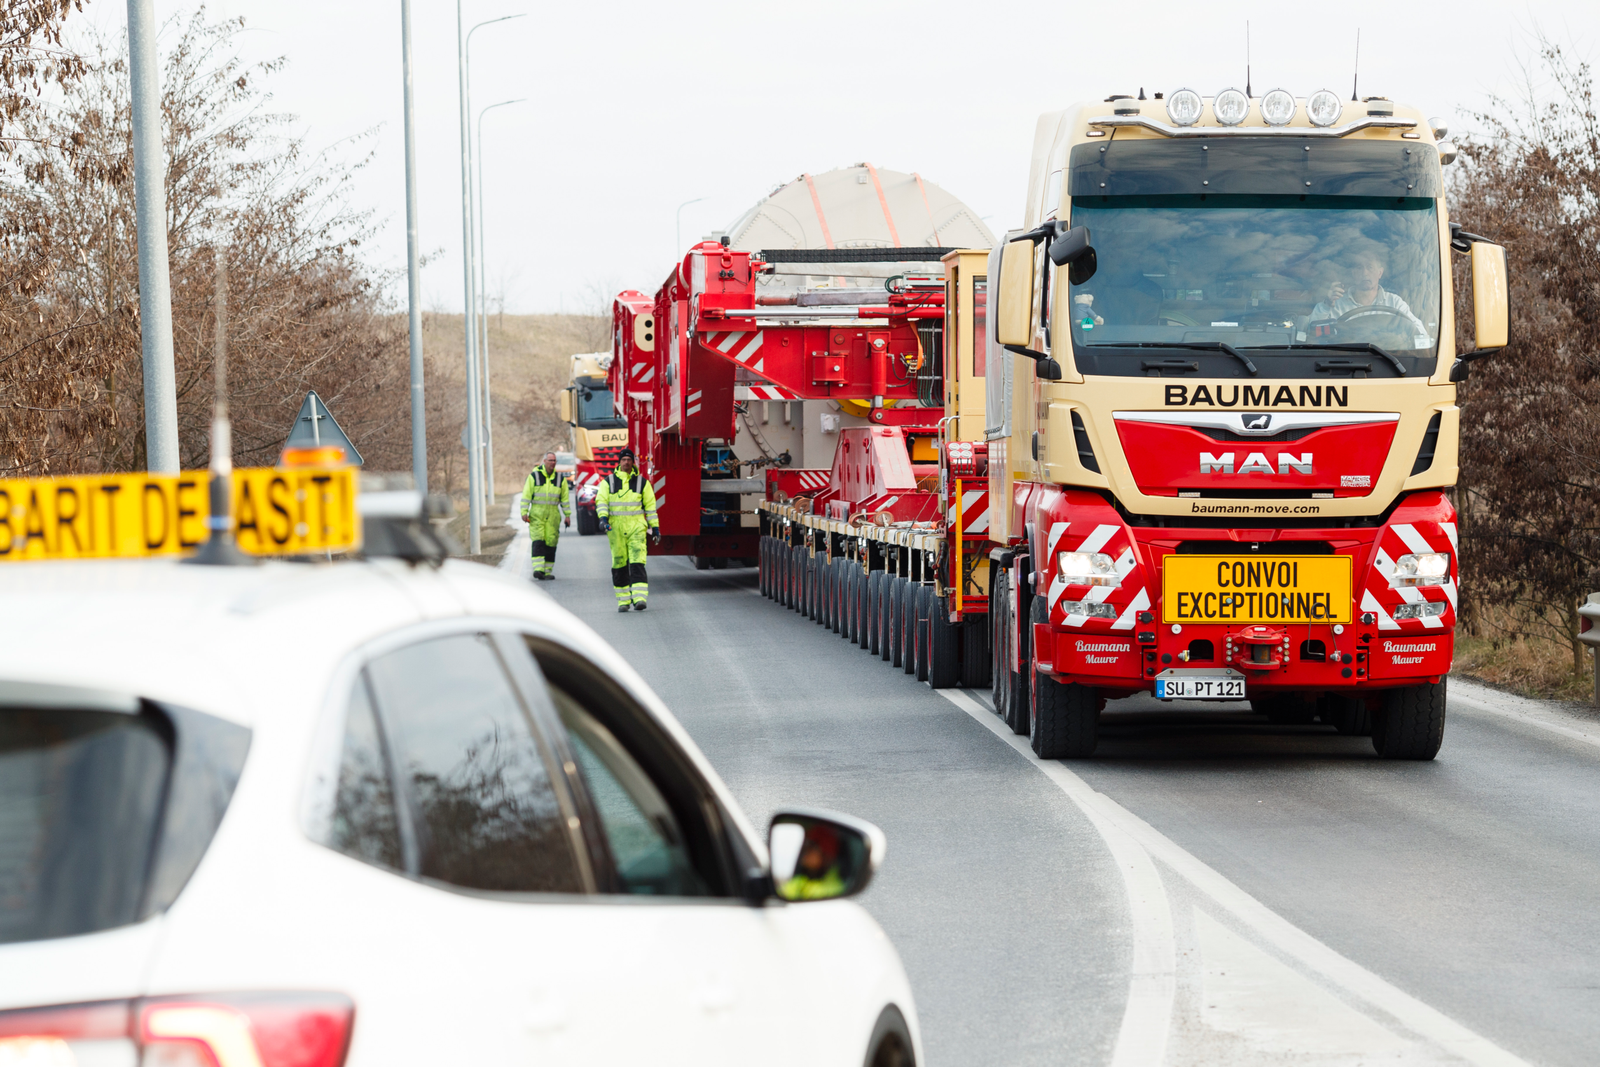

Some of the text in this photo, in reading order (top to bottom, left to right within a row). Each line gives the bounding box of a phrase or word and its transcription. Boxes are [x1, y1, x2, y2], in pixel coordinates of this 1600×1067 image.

[1165, 385, 1348, 407] BAUMANN
[1200, 452, 1313, 475] MAN
[143, 475, 350, 549] DEASIT!
[1191, 502, 1320, 514] baumann-move.com
[1217, 561, 1298, 588] CONVOI
[1177, 592, 1337, 618] EXCEPTIONNEL
[1075, 640, 1130, 652] Baumann
[1383, 640, 1436, 652] Baumann
[1085, 654, 1119, 664] Maurer
[1391, 655, 1424, 664] Maurer
[1166, 682, 1184, 696] SU
[1195, 682, 1213, 696] PT
[1217, 682, 1243, 696] 121
